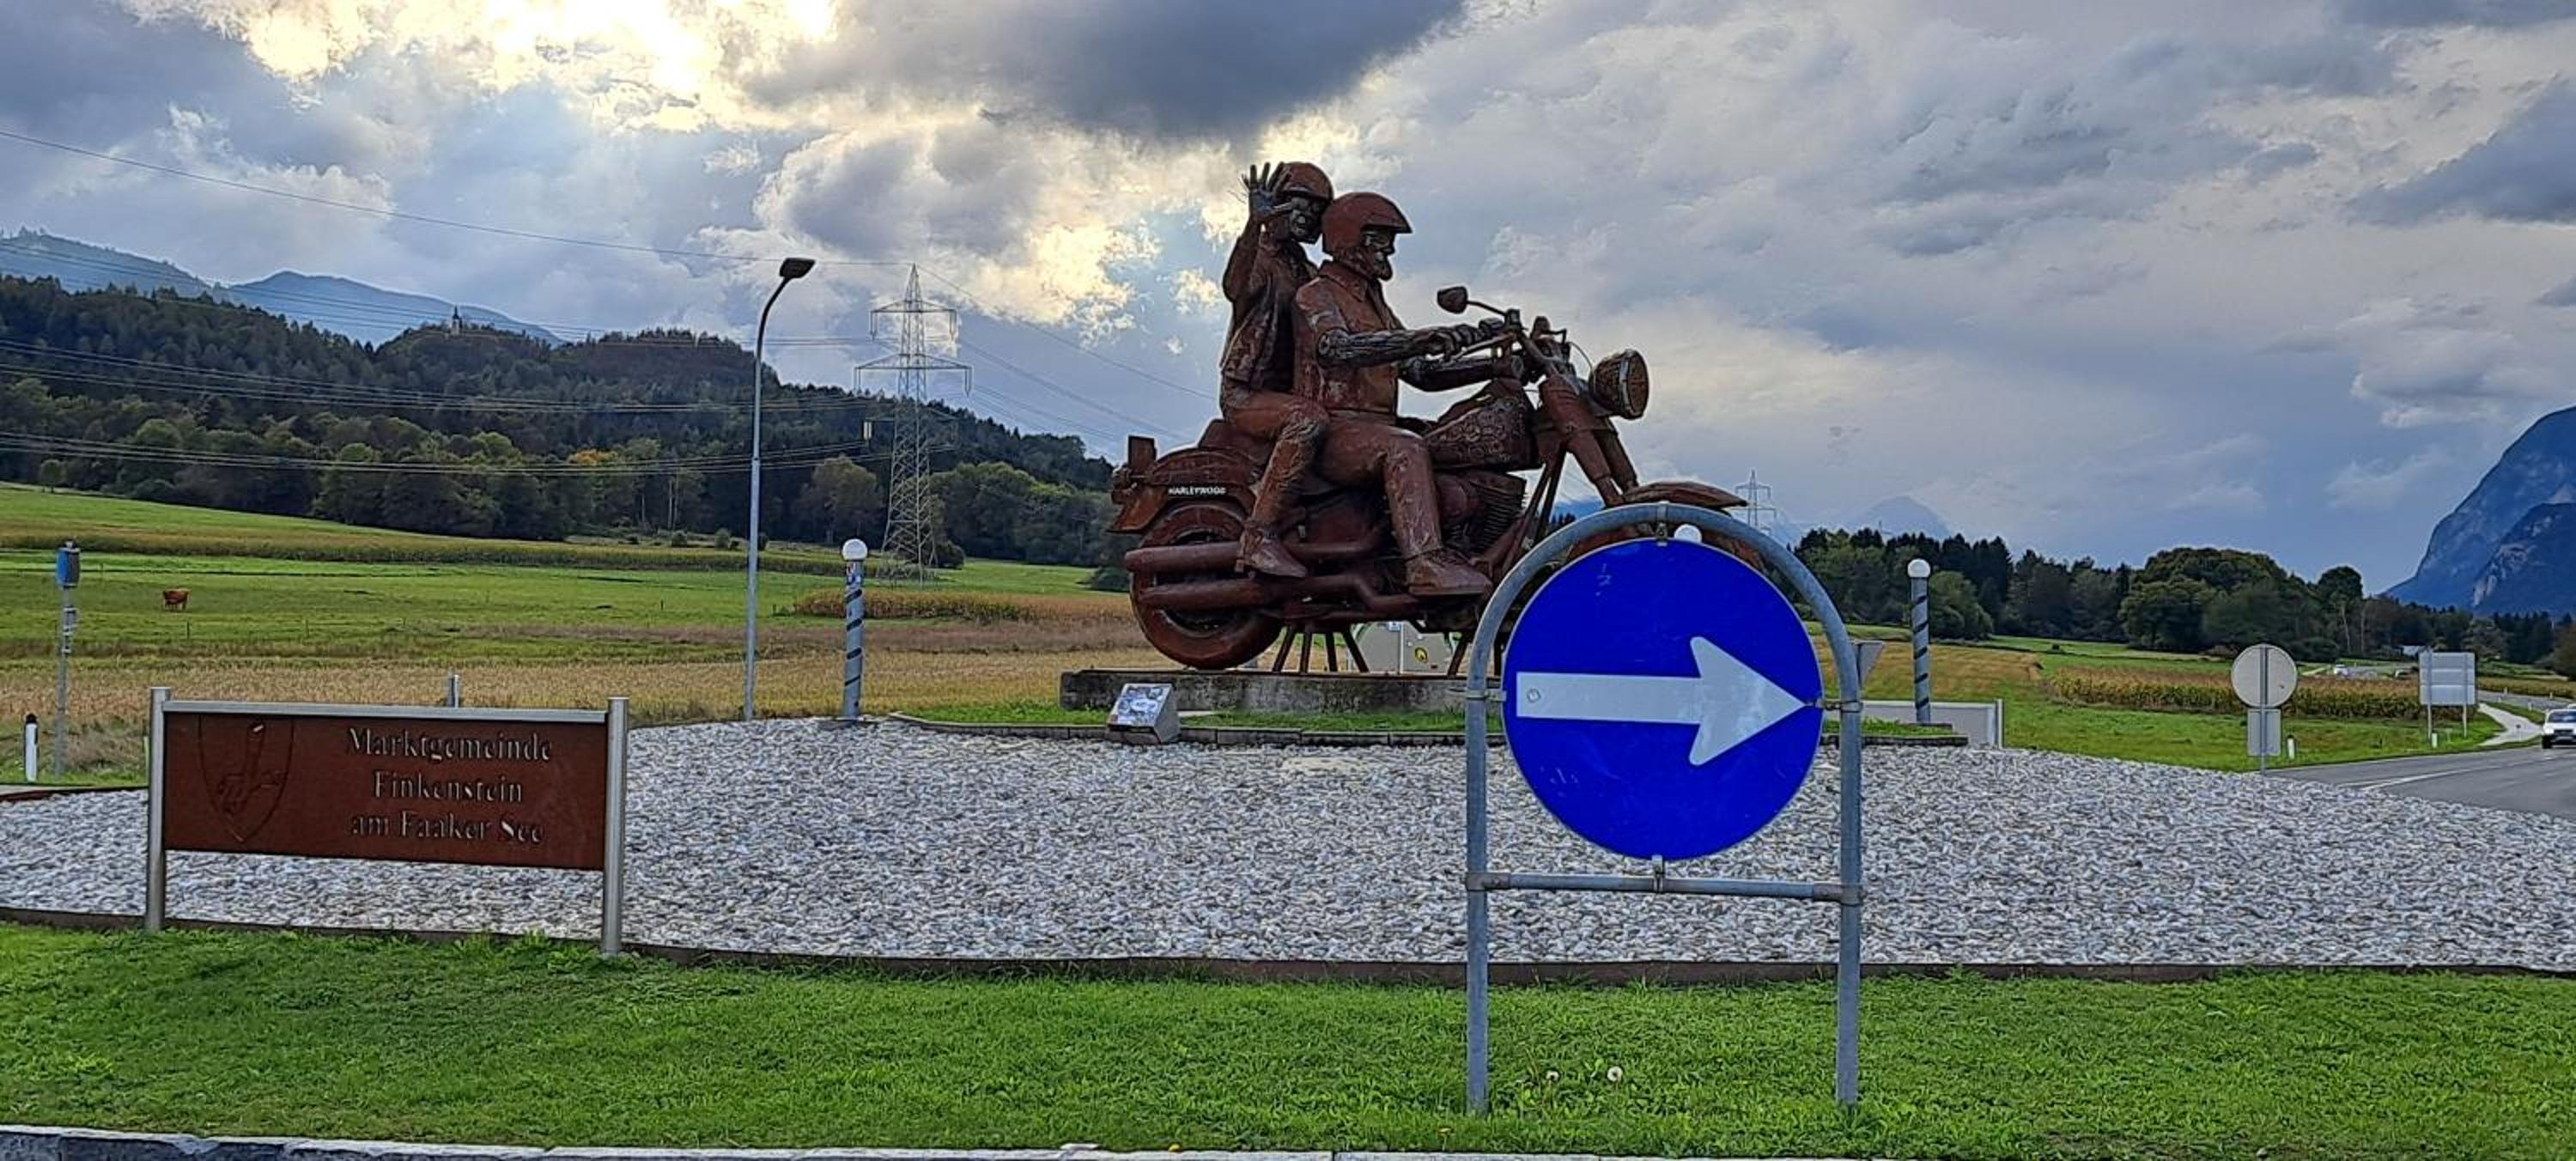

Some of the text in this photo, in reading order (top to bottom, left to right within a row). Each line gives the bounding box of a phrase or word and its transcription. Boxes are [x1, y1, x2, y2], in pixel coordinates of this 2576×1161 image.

[349, 727, 552, 763] Marktgemeinde
[374, 770, 522, 802] Finkenstein
[351, 810, 543, 843] am Faaker See
